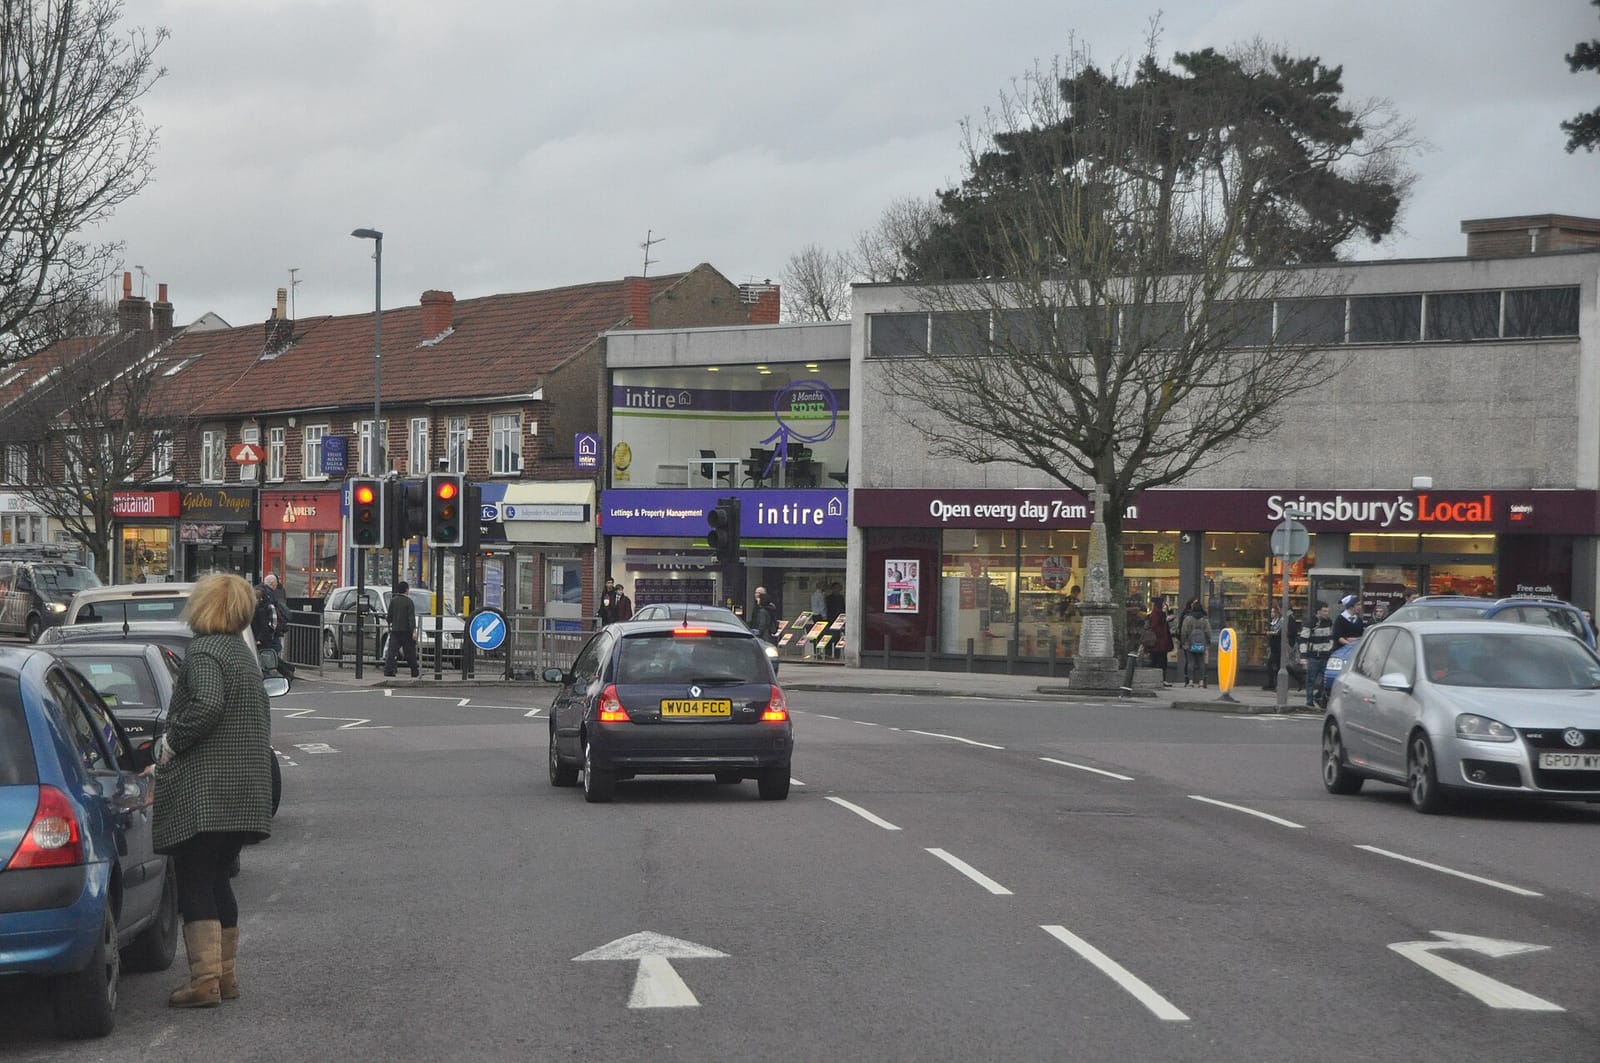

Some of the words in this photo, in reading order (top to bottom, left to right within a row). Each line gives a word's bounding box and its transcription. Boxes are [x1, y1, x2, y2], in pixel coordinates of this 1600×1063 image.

[626, 389, 676, 408] intire
[798, 391, 823, 402] Months
[791, 403, 825, 419] FREE
[113, 494, 155, 513] motaman
[183, 492, 213, 510] Golden
[218, 491, 250, 512] Dragon
[930, 499, 971, 521] Open
[974, 505, 1016, 521] every
[1019, 501, 1048, 521] day
[1051, 501, 1087, 518] 7am
[611, 509, 633, 519] Lettings
[634, 509, 640, 517] &
[641, 509, 665, 519] Property
[667, 509, 703, 519] Management
[758, 502, 824, 525] intire
[1267, 495, 1414, 527] Sainsbury's
[1418, 496, 1493, 521] Local
[1516, 584, 1533, 592] Free
[1534, 585, 1552, 593] cash
[667, 702, 699, 713] WV04
[702, 702, 725, 713] FCC
[1545, 755, 1579, 768] GP07
[1584, 756, 1600, 768] WY
